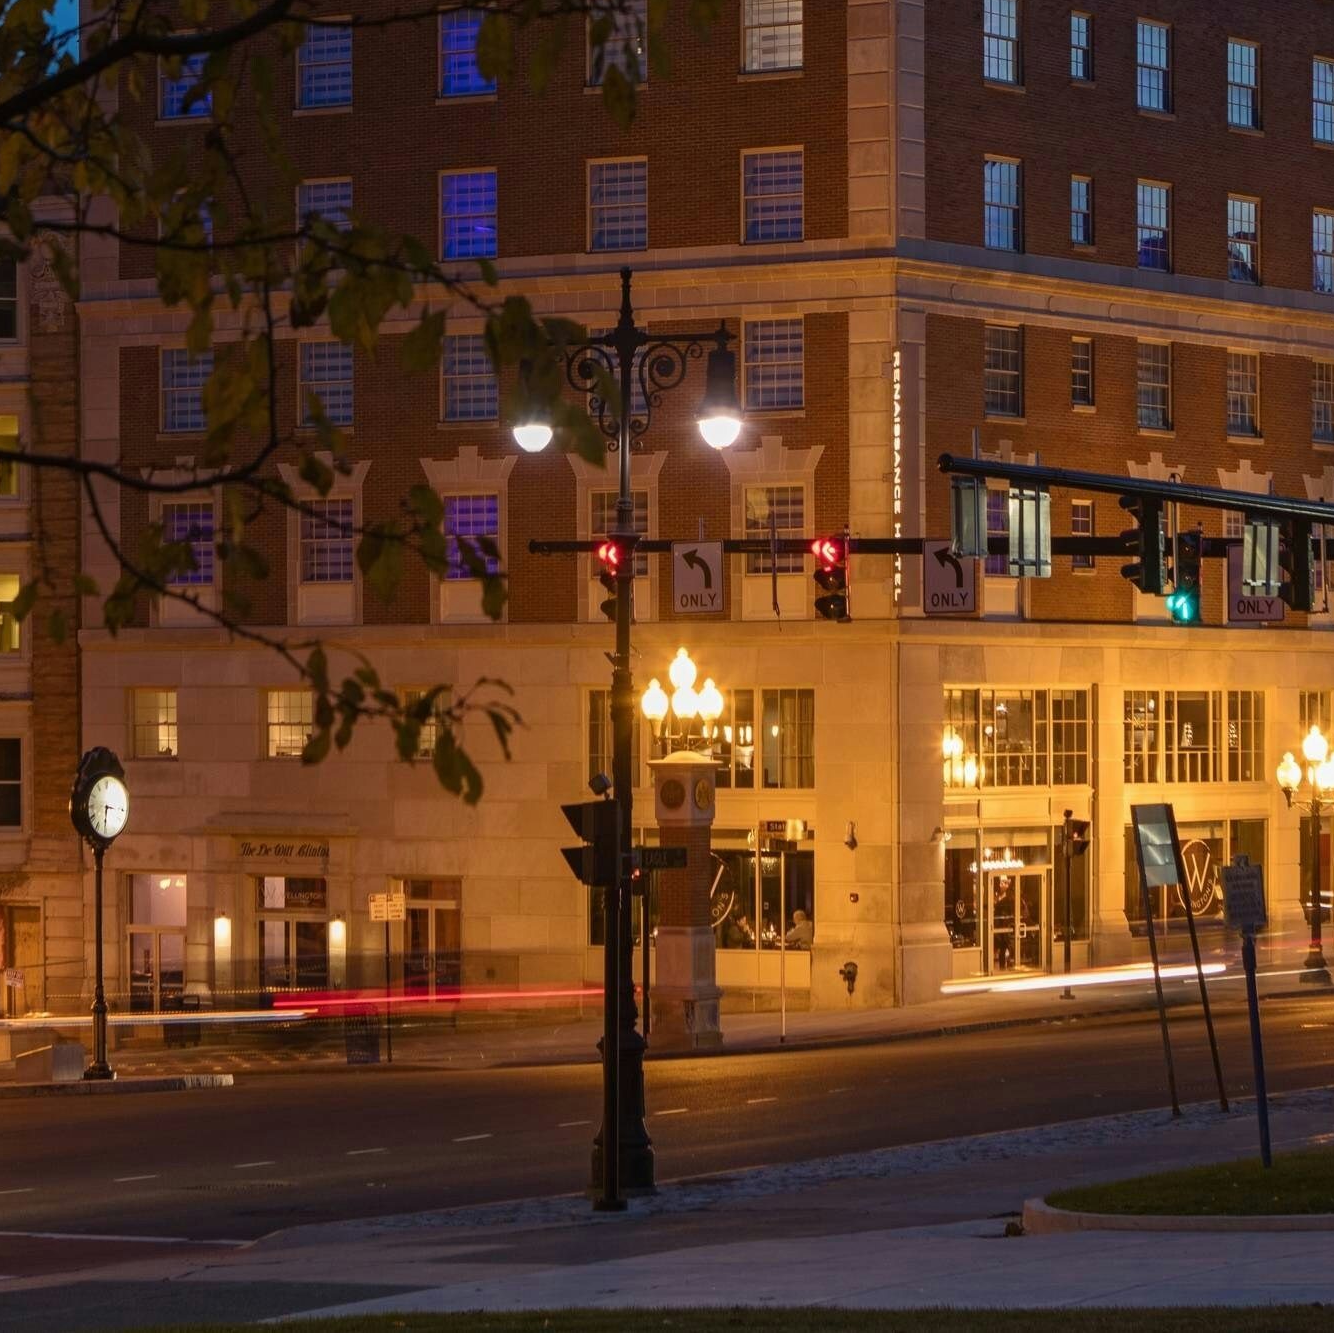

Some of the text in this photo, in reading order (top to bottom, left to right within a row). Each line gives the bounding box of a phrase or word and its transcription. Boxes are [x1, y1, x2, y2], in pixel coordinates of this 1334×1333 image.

[892, 351, 902, 603] RENAISSANCE HTEL
[680, 593, 717, 608] ONLY
[931, 592, 969, 607] ONLY
[1236, 600, 1275, 615] ONLY
[241, 841, 257, 857] The
[1182, 852, 1211, 893] W
